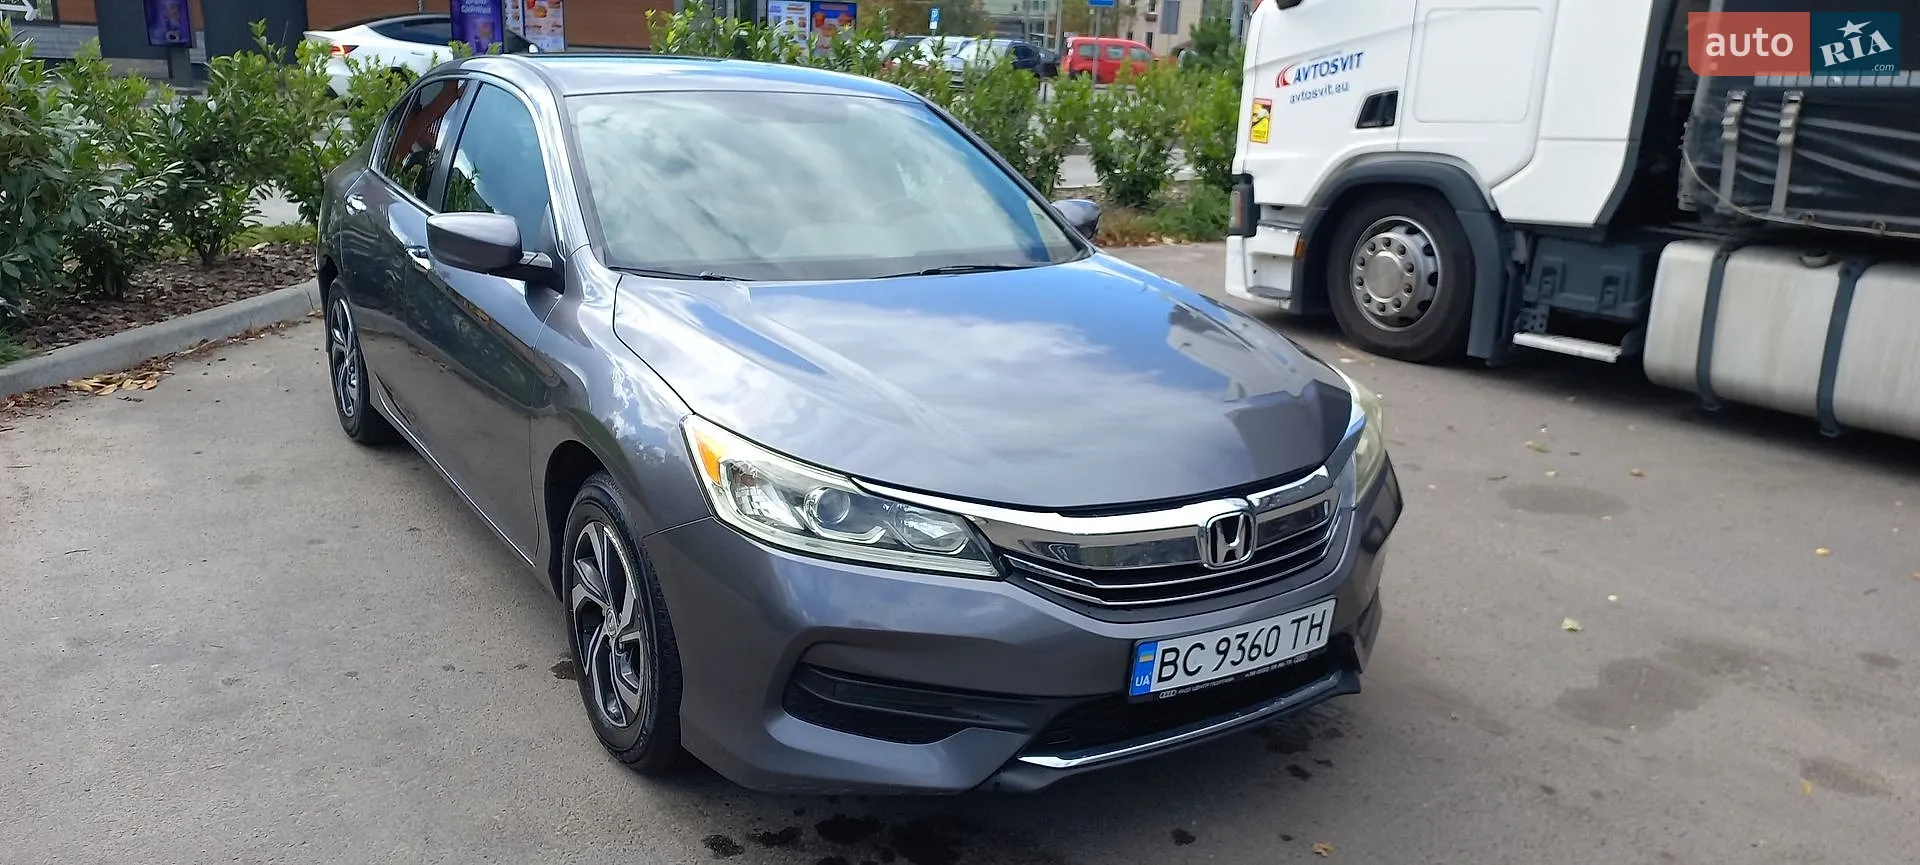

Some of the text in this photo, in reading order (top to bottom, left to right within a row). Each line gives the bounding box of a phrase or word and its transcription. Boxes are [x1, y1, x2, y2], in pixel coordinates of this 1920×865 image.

[1293, 52, 1364, 84] AVTOSVIT
[1289, 82, 1350, 104] avtosvit.eu
[1157, 642, 1205, 683] BC
[1212, 625, 1280, 672] 9360
[1290, 609, 1327, 650] TH
[1135, 673, 1150, 687] UA
